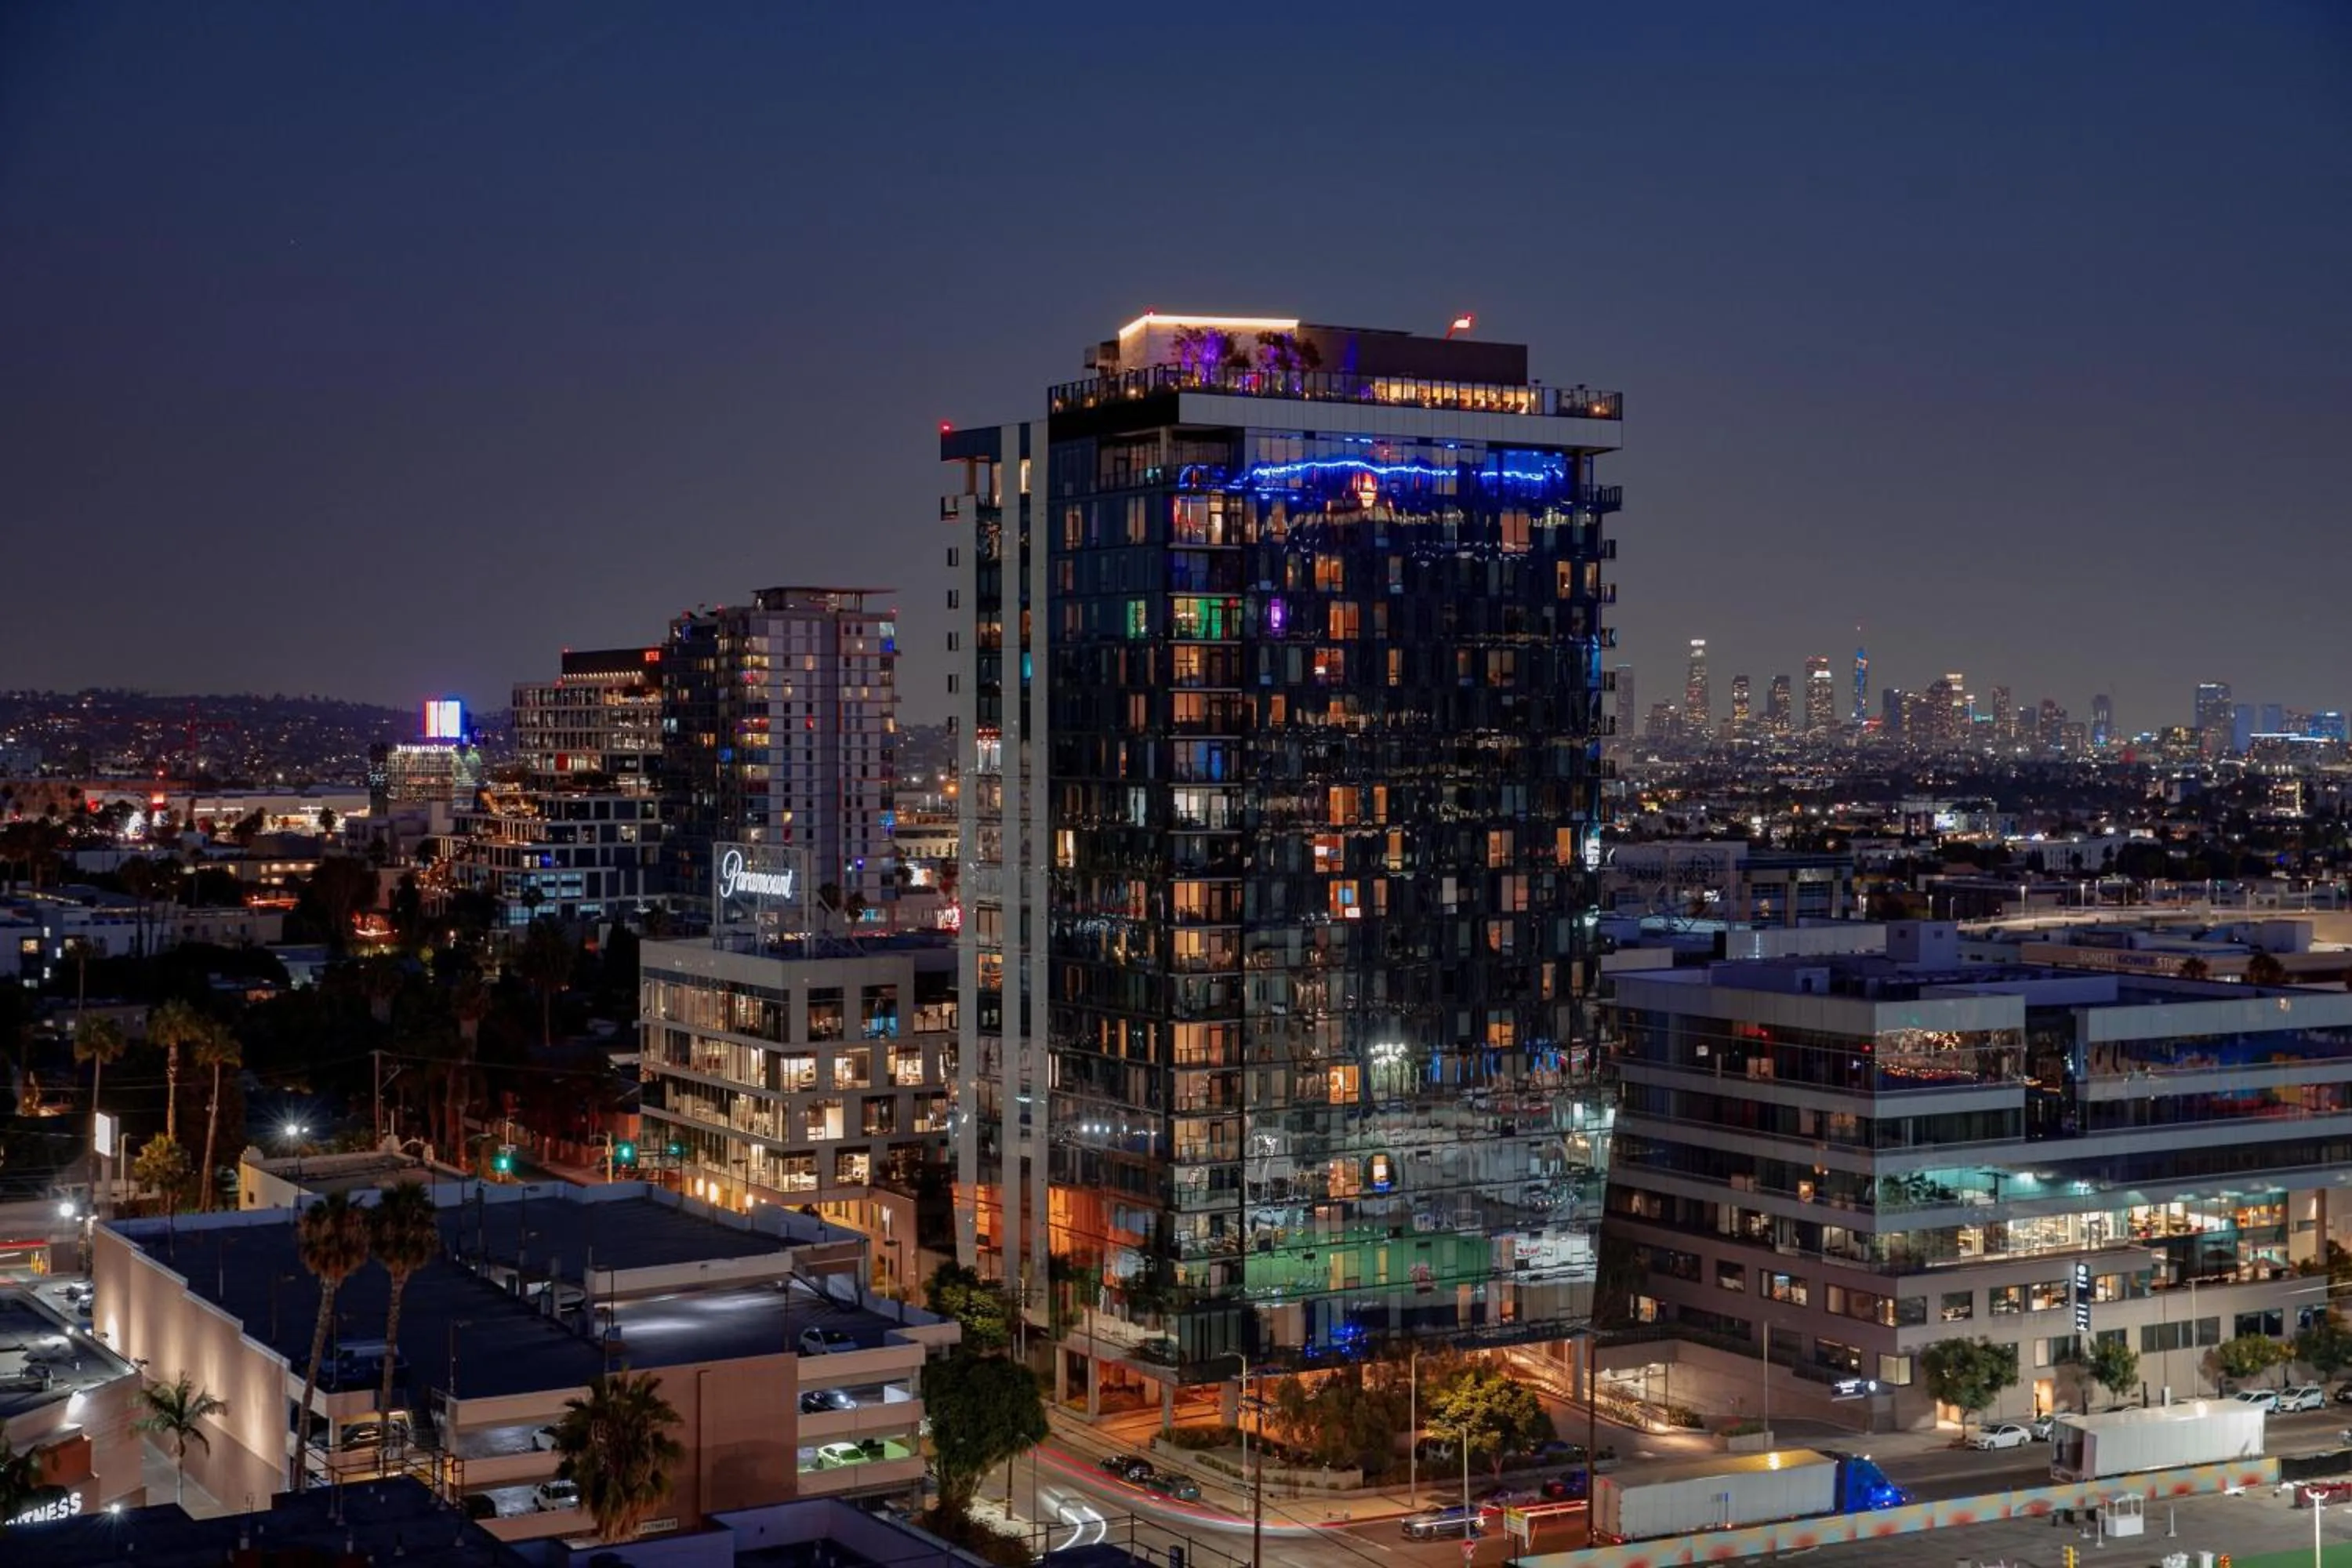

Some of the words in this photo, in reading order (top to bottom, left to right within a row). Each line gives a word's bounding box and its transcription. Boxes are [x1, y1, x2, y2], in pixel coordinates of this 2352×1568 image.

[720, 849, 793, 898] Paramount
[2078, 950, 2115, 965] SUNSET
[5, 1492, 82, 1526] TNESS
